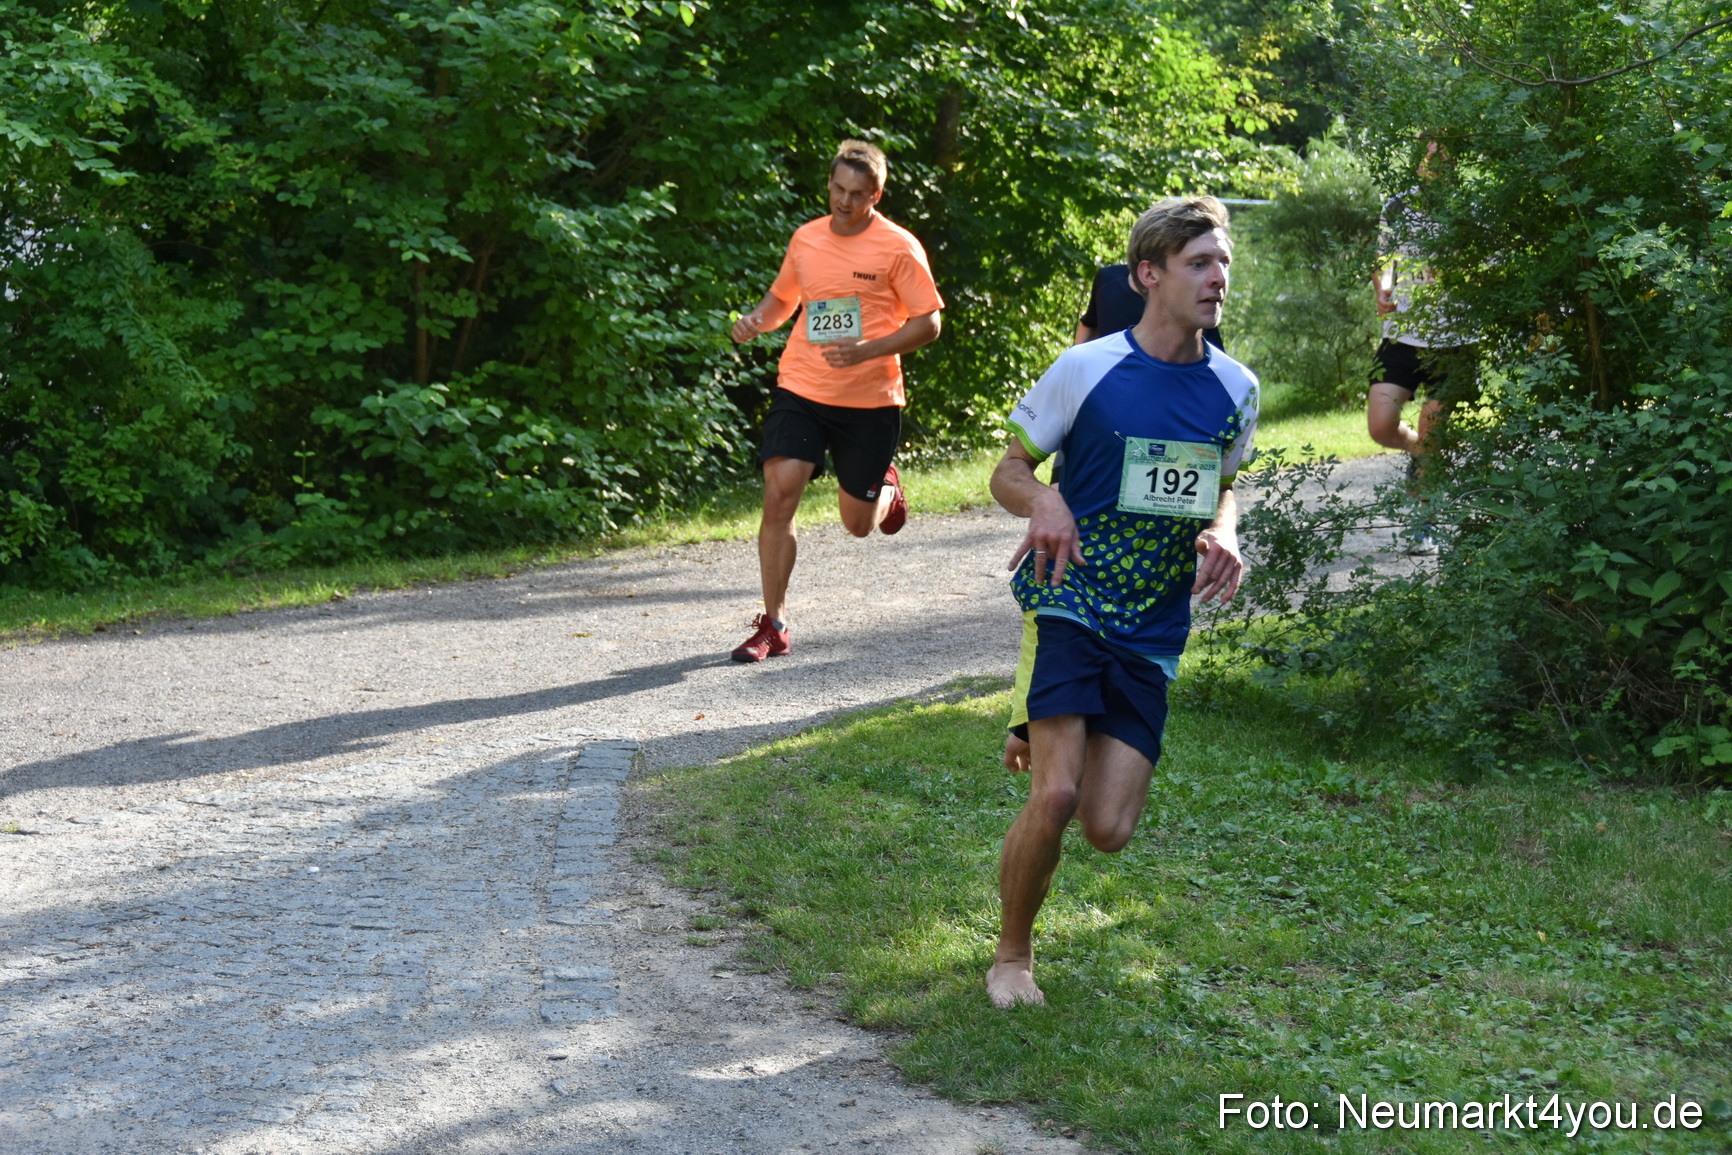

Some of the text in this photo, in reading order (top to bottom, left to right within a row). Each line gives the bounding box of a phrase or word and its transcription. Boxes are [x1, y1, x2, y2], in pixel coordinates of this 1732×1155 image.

[853, 271, 876, 281] THULE
[812, 313, 853, 331] 2283
[1146, 467, 1199, 496] 192
[1143, 494, 1197, 505] Albrecht Peter
